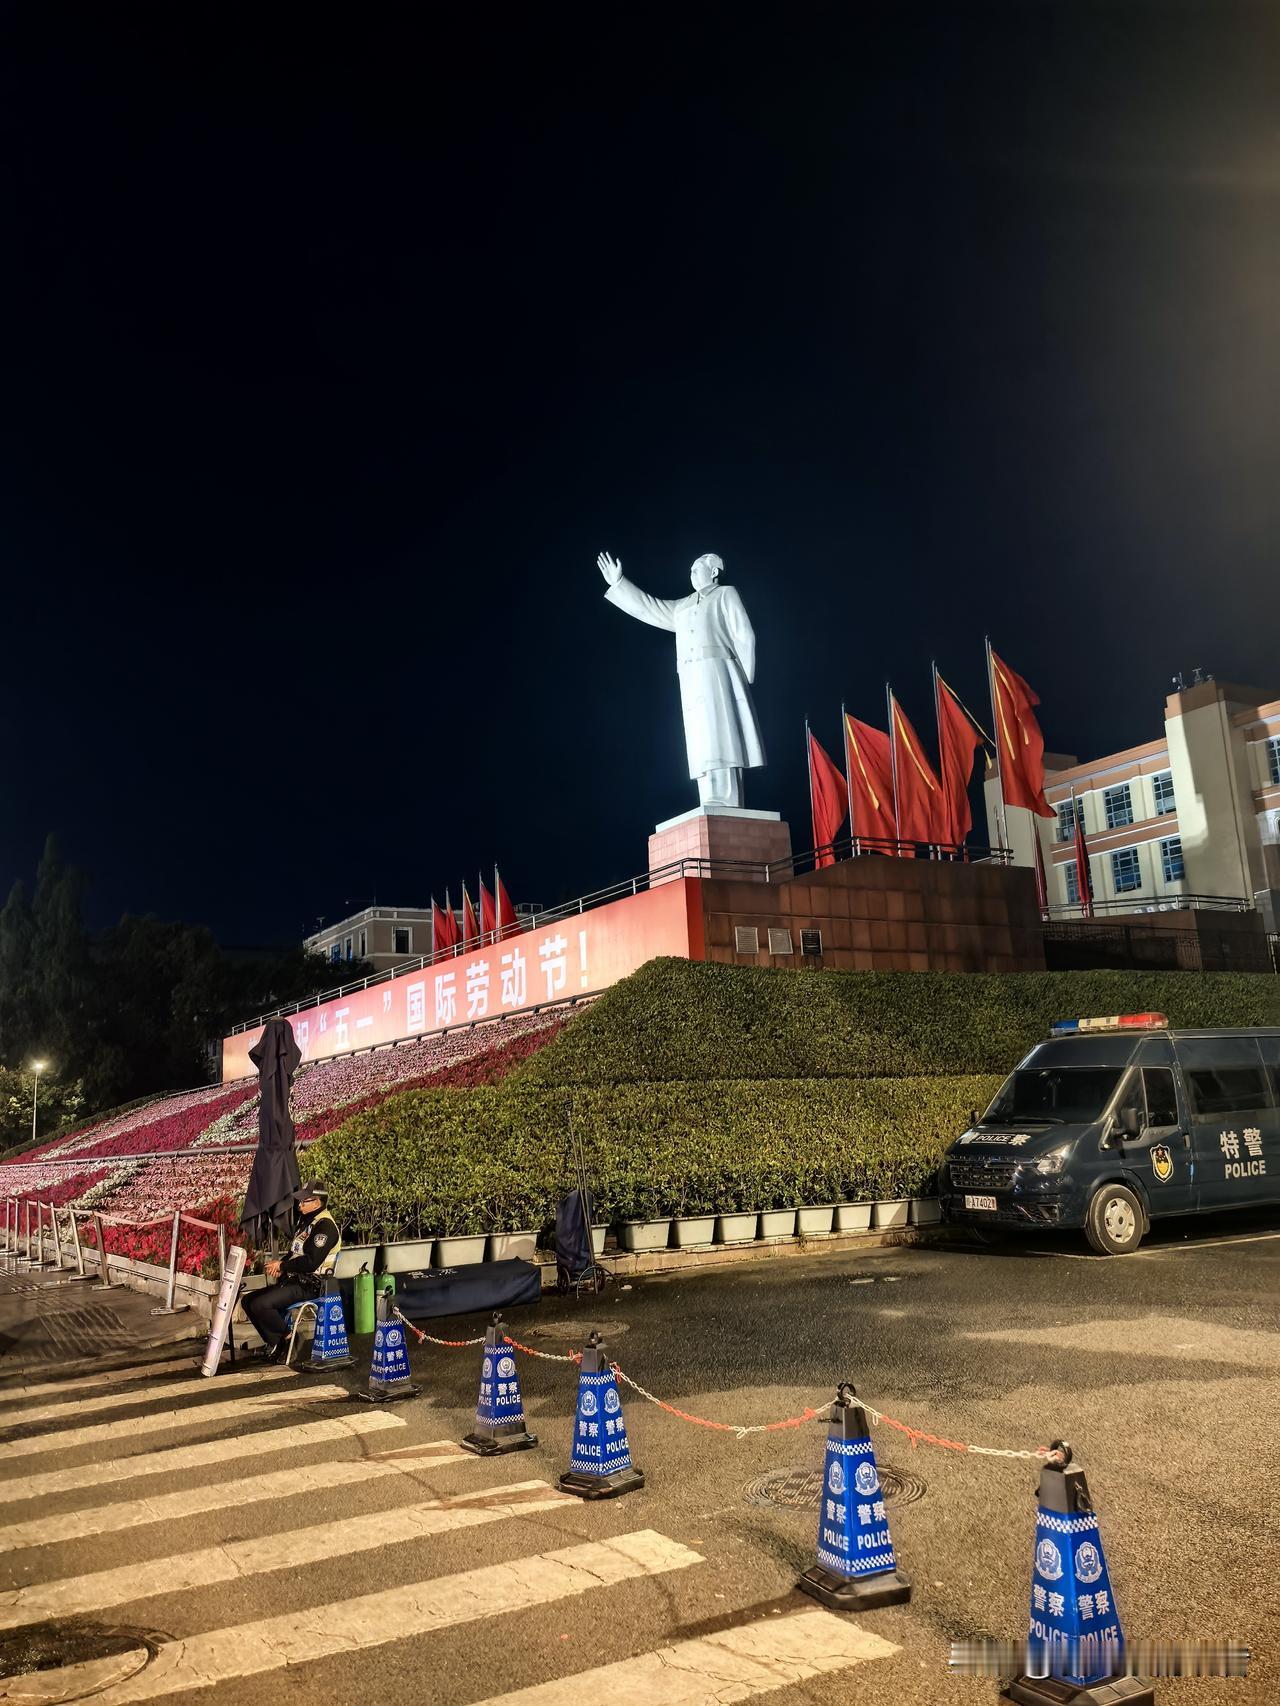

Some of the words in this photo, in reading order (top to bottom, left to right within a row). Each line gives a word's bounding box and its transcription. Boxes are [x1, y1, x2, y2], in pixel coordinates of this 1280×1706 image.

[1220, 1128, 1262, 1159] 特警
[1225, 1160, 1266, 1179] POLICE
[328, 1337, 348, 1347] POLICE
[385, 1363, 406, 1373] POLICE
[498, 1381, 518, 1395] 警察
[496, 1394, 520, 1406] POLICE
[579, 1420, 598, 1437] 警察
[605, 1417, 624, 1435] 警察
[576, 1443, 601, 1456] POLICE
[606, 1437, 629, 1454] POLICE
[826, 1499, 847, 1524] 警察
[857, 1501, 886, 1525] 警察
[823, 1528, 849, 1551] POLICE
[857, 1529, 892, 1550] POLICE
[1033, 1584, 1064, 1617] 警察
[1078, 1590, 1110, 1620] 警察
